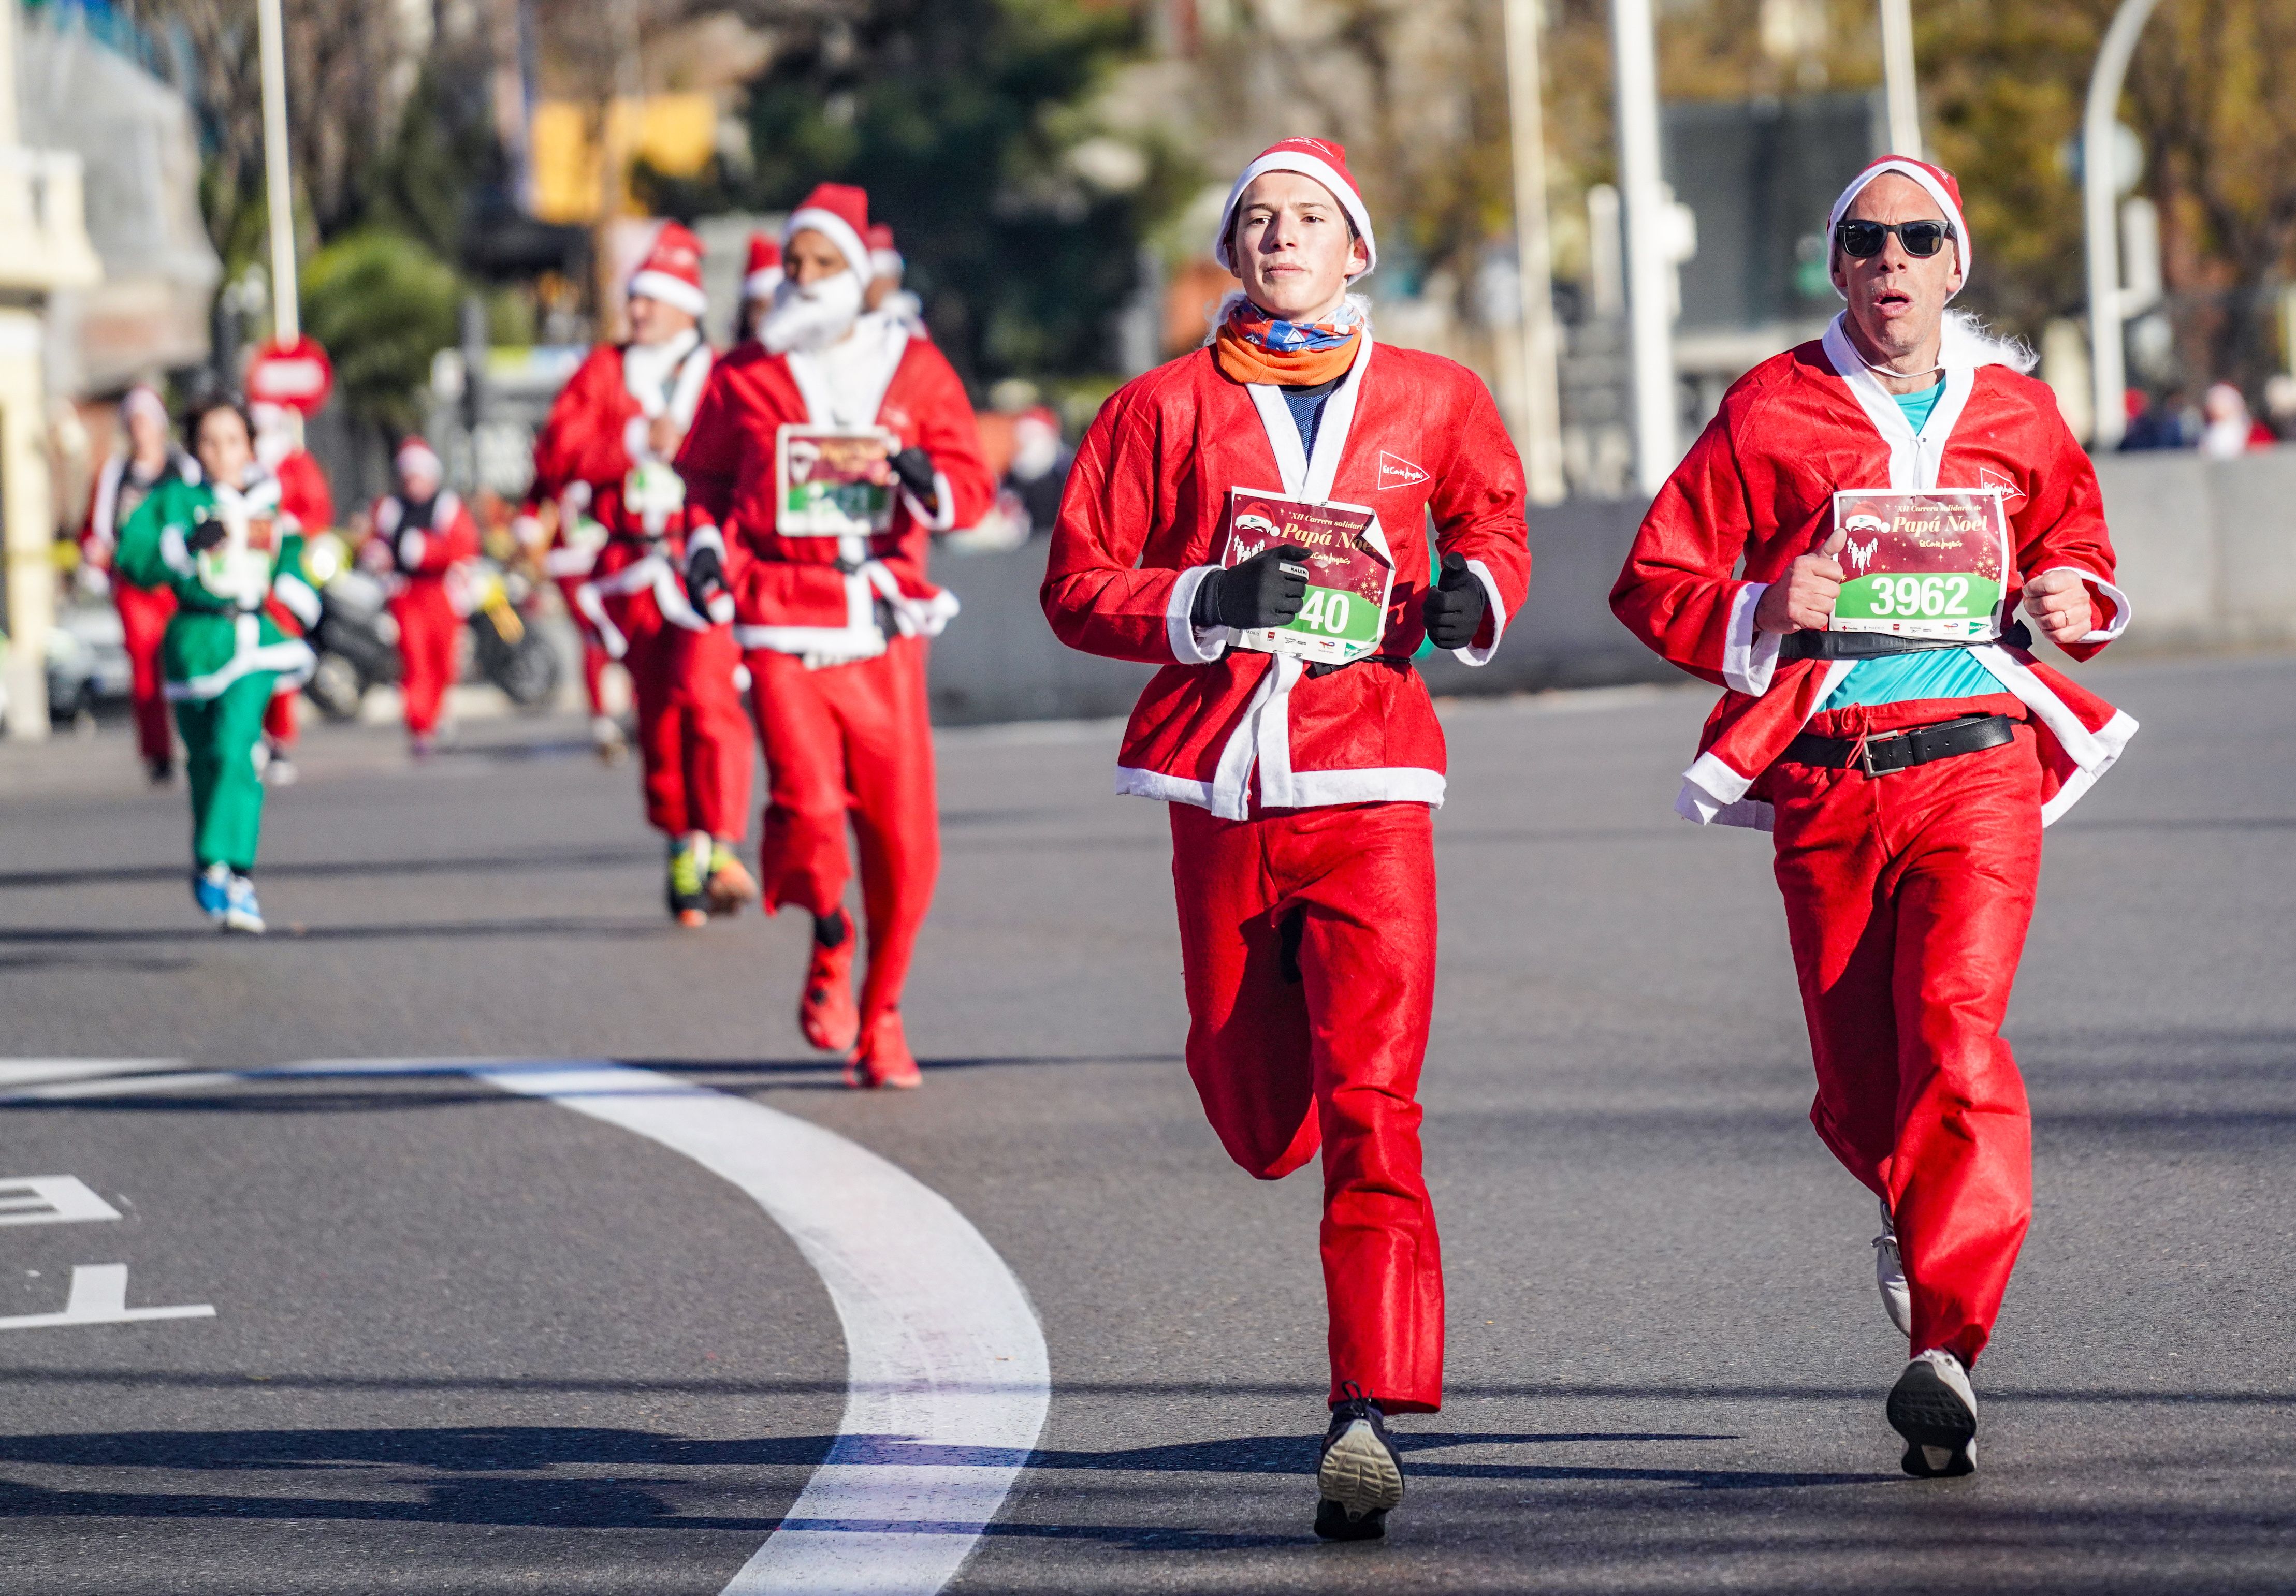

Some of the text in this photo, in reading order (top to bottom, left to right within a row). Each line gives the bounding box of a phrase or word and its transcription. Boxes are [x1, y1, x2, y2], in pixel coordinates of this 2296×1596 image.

[1389, 466, 1405, 476] Corte
[1291, 512, 1304, 521] XII
[1305, 515, 1333, 525] Carrera
[1891, 515, 1988, 537] Papá Noel
[1281, 522, 1333, 548] Papá
[1314, 552, 1328, 562] Corte
[1328, 552, 1351, 565] Inglés
[1870, 576, 1969, 616] 3962
